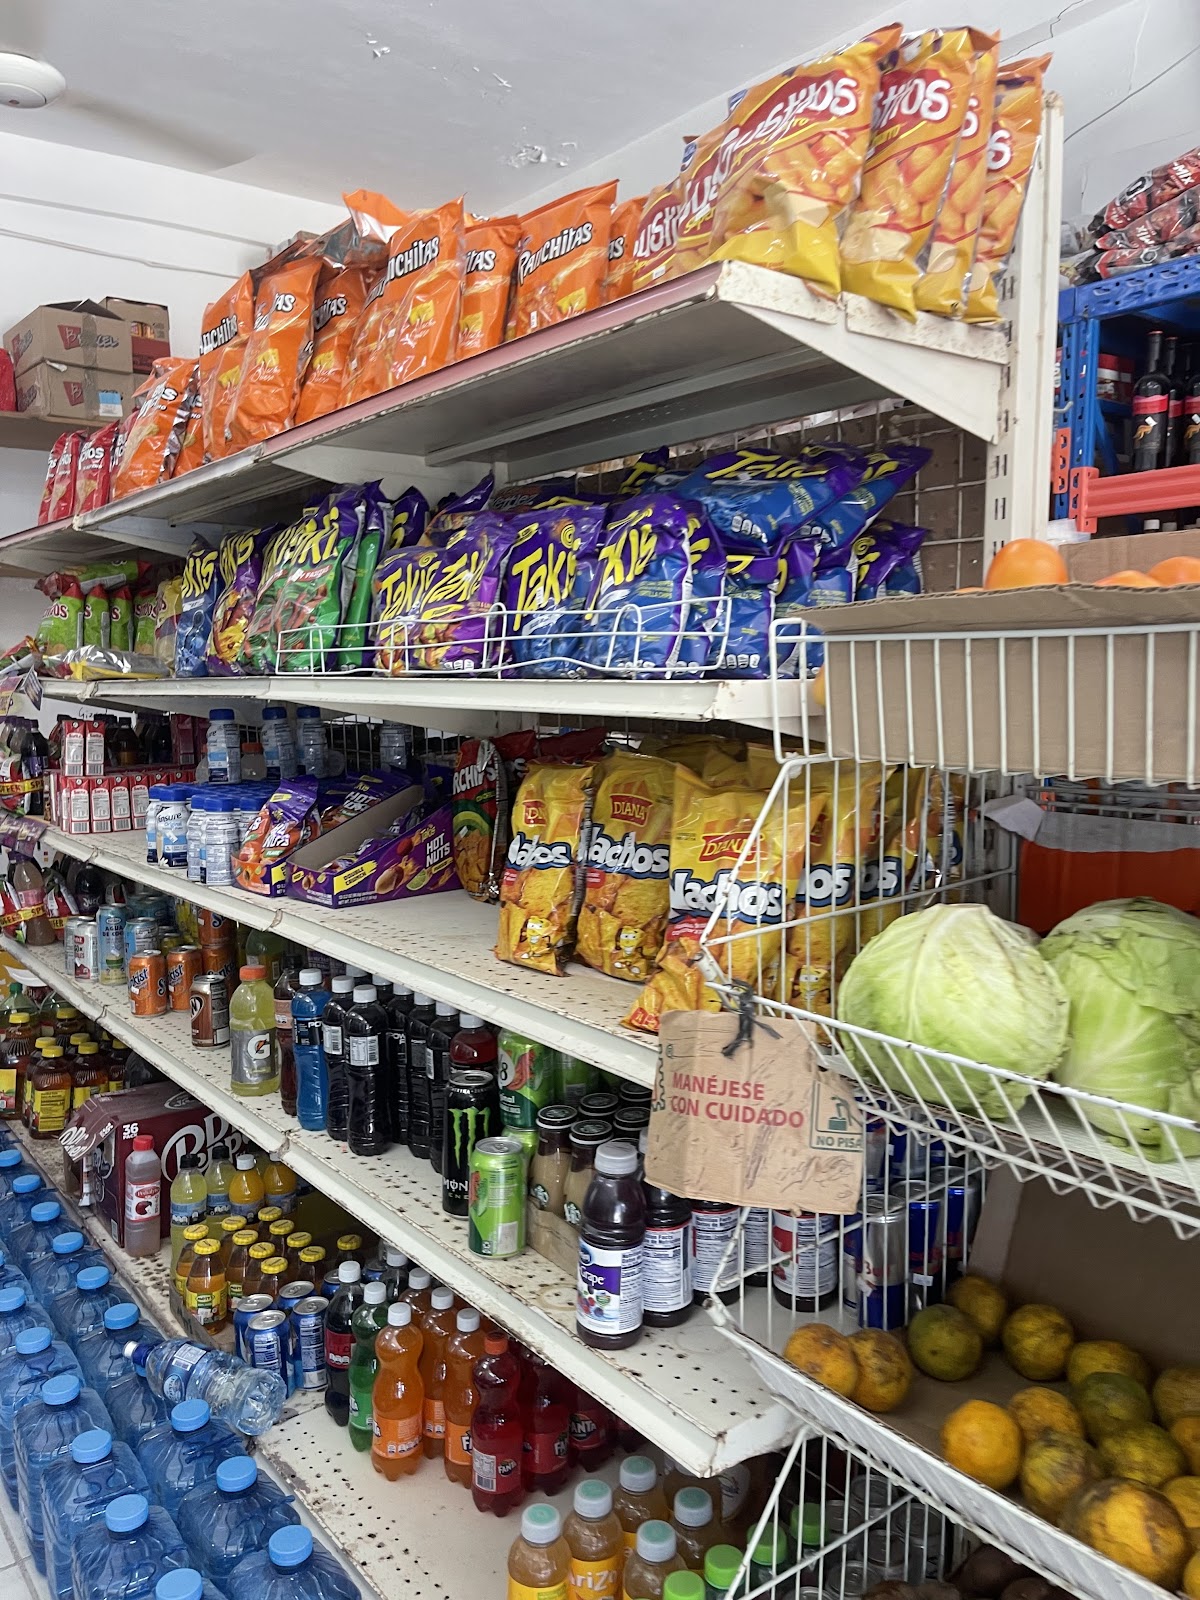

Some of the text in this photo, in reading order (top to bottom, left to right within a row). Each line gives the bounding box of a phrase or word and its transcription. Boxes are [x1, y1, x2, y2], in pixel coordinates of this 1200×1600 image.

[613, 801, 646, 820] DIANA
[426, 833, 445, 855] HOT
[426, 842, 451, 867] NUTS
[343, 867, 364, 881] DOUBLE
[345, 872, 366, 886] CRUNCH
[672, 1072, 765, 1101] MANÉJESE
[670, 1095, 804, 1129] CON CUIDADO
[122, 1123, 139, 1136] 36
[816, 1135, 835, 1148] NO
[579, 1265, 606, 1287] Grape
[497, 1459, 517, 1475] FANTA
